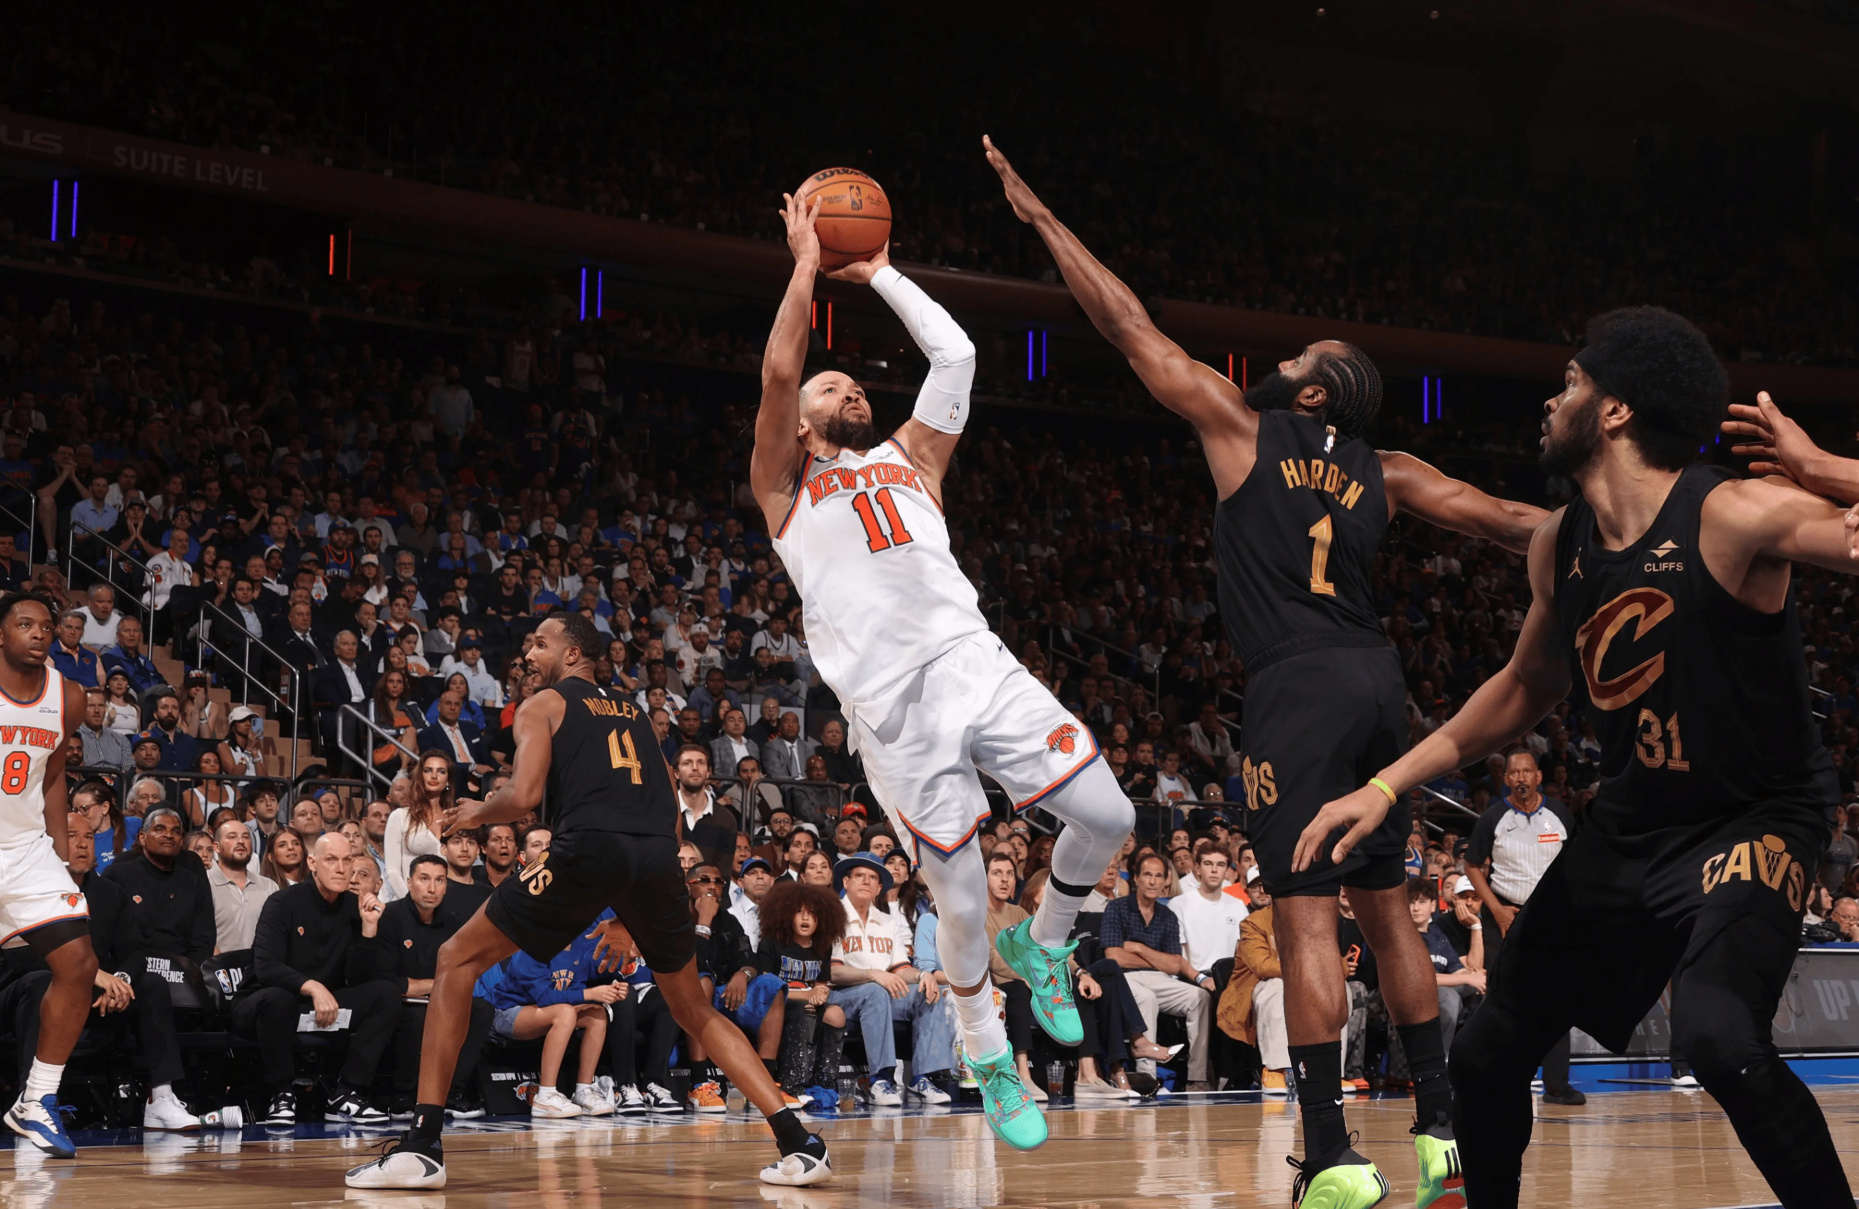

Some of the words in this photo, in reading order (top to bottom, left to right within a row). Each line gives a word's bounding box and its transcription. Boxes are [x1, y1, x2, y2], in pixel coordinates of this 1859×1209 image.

[112, 146, 187, 177] SUITE
[195, 160, 268, 192] LEVEL
[806, 467, 857, 508] NEW
[857, 462, 923, 494] YORK
[1280, 458, 1365, 510] HARDEN
[851, 487, 914, 554] 11
[1308, 513, 1337, 597] 1
[1644, 562, 1684, 572] CLIFFS
[582, 697, 639, 722] MOBLEY
[20, 726, 59, 750] YORK
[607, 728, 643, 785] 4
[1635, 708, 1690, 772] 31
[1, 751, 31, 795] 8
[1702, 834, 1805, 912] CAVS
[146, 956, 170, 971] STERN
[1814, 979, 1851, 1021] UP
